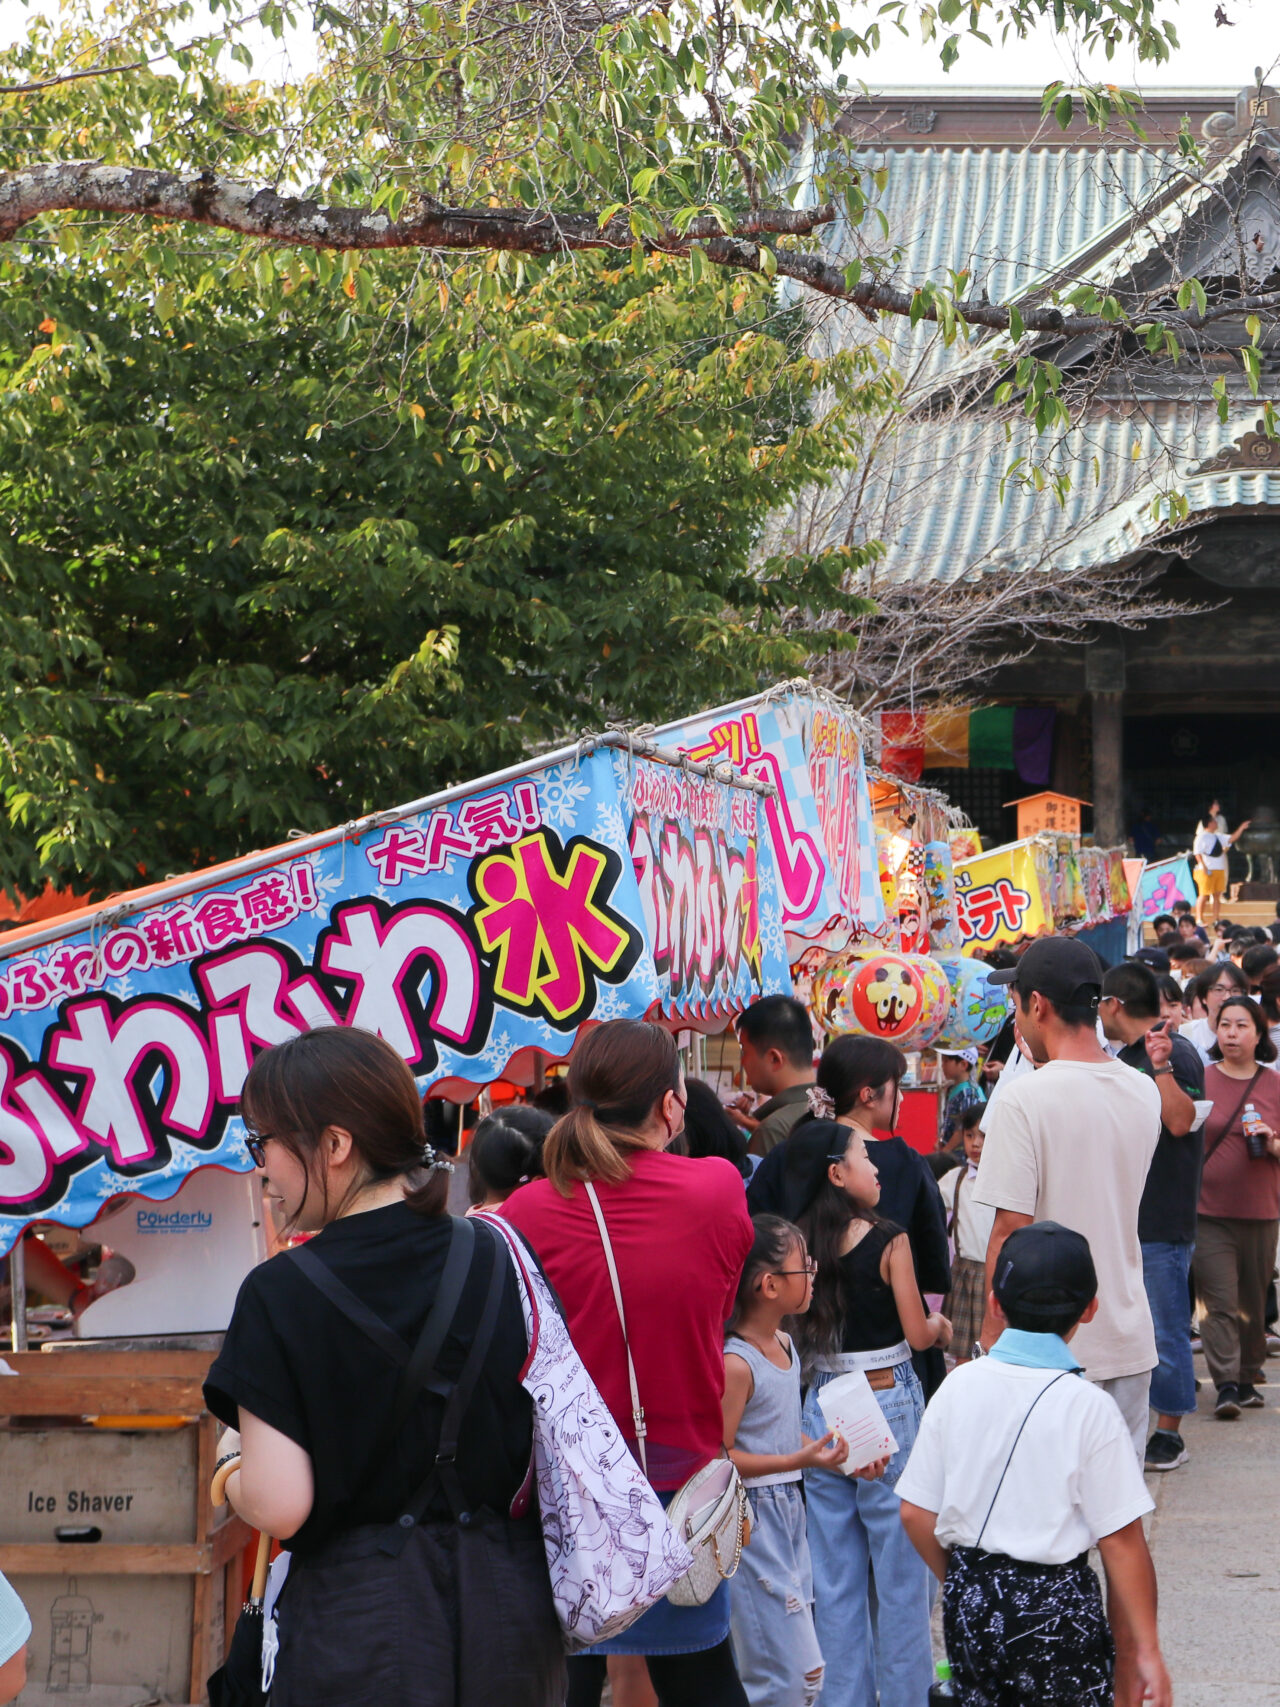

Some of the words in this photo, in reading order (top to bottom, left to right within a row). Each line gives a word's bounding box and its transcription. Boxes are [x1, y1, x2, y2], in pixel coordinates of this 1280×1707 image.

[367, 782, 543, 886] 大人気!
[0, 861, 318, 1019] ふわの新食感!
[137, 1210, 212, 1229] Powderly
[28, 1491, 57, 1513] Ice
[67, 1490, 133, 1513] Shaver
